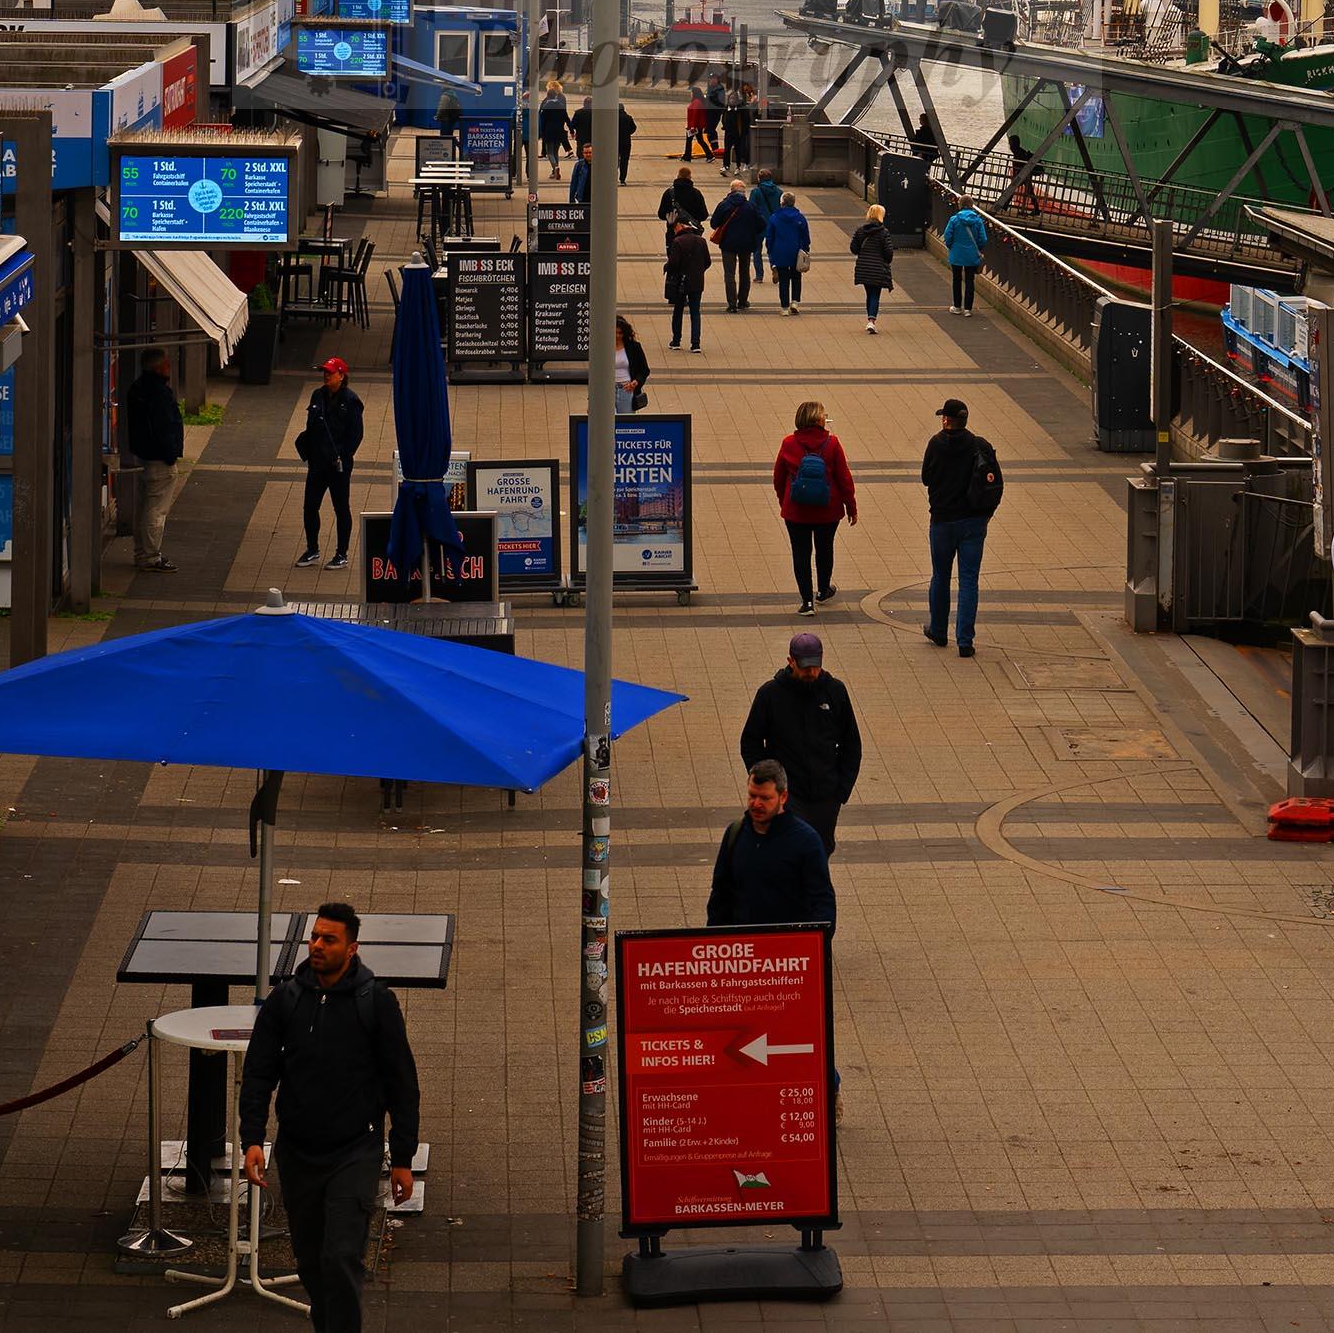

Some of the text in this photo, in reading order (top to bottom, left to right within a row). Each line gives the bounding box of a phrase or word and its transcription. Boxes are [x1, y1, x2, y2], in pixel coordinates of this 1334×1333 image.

[160, 161, 176, 172] Std.
[252, 162, 287, 172] Std. XXL
[123, 168, 139, 179] 55
[221, 169, 236, 180] 70
[159, 200, 176, 210] Std.
[252, 202, 286, 212] Std. XXL
[123, 208, 138, 218] 70
[219, 208, 244, 220] 220
[569, 210, 585, 220] ECK
[547, 222, 575, 230] GETRÄNKE
[496, 259, 514, 272] ECK
[458, 274, 515, 283] FISCHBRÖTCHEN
[548, 284, 587, 294] SPEISEN
[617, 439, 671, 450] TICKETS FÜR
[497, 478, 530, 486] GROSSE
[487, 487, 543, 495] HAFENRUND-
[500, 496, 527, 504] FAHRT
[499, 542, 521, 550] TICKETS
[691, 942, 755, 960] GROßE
[637, 956, 810, 978] HAFENRUNDFAHRT
[659, 976, 804, 990] Barkassen Fahrgastschiffen!
[711, 992, 752, 1005] Schiffstyp
[679, 1004, 743, 1016] Speicherstadt
[640, 1040, 691, 1052] TICKETS
[641, 1054, 715, 1066] INFOS HIER!
[642, 1088, 814, 1102] Erwachsene 25,00
[792, 1098, 813, 1106] 18,00
[643, 1111, 815, 1126] Kinder 12,00
[799, 1121, 815, 1129] 9,00
[643, 1133, 815, 1146] Familie Kinder) 54,00
[675, 1202, 785, 1215] BARKASSEN-MEYER
